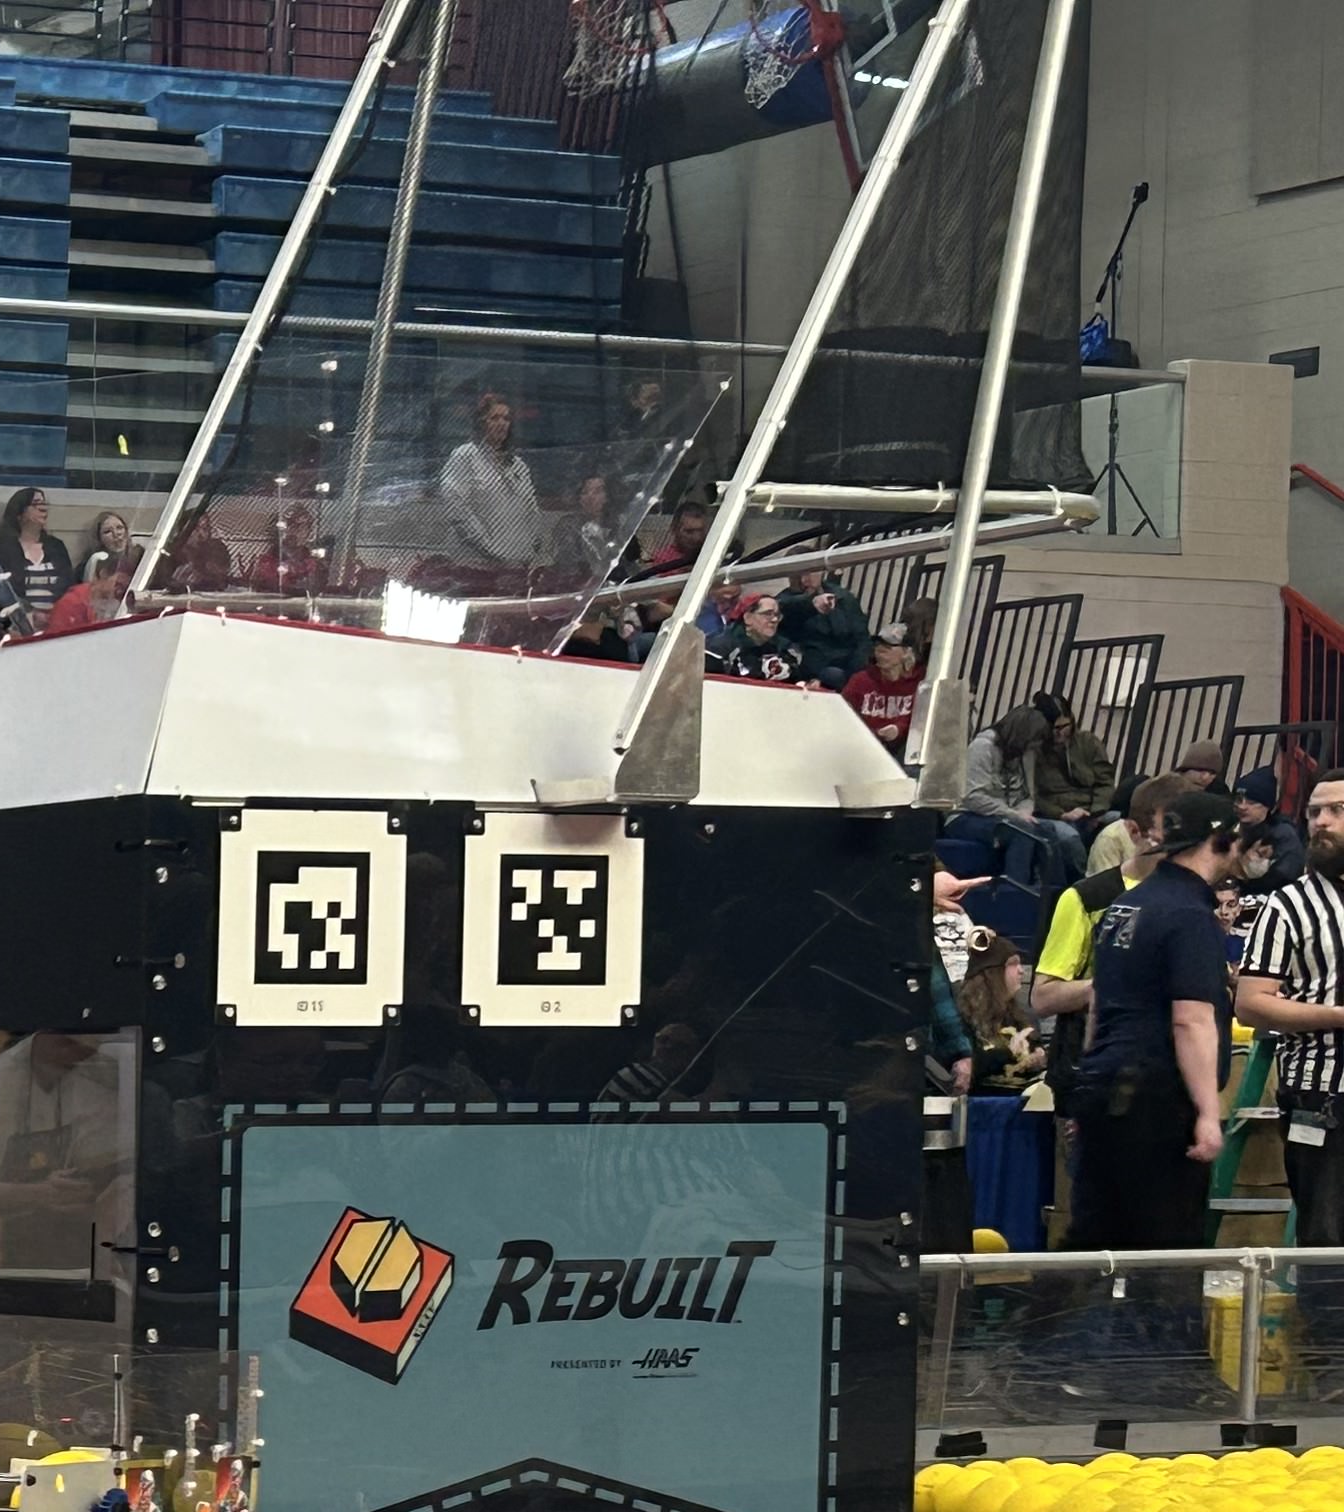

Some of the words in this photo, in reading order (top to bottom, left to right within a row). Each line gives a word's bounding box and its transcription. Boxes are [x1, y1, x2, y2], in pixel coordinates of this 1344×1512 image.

[476, 1239, 777, 1330] REBUILT
[550, 1359, 607, 1369] PRESENTED
[632, 1347, 700, 1369] HAAS
